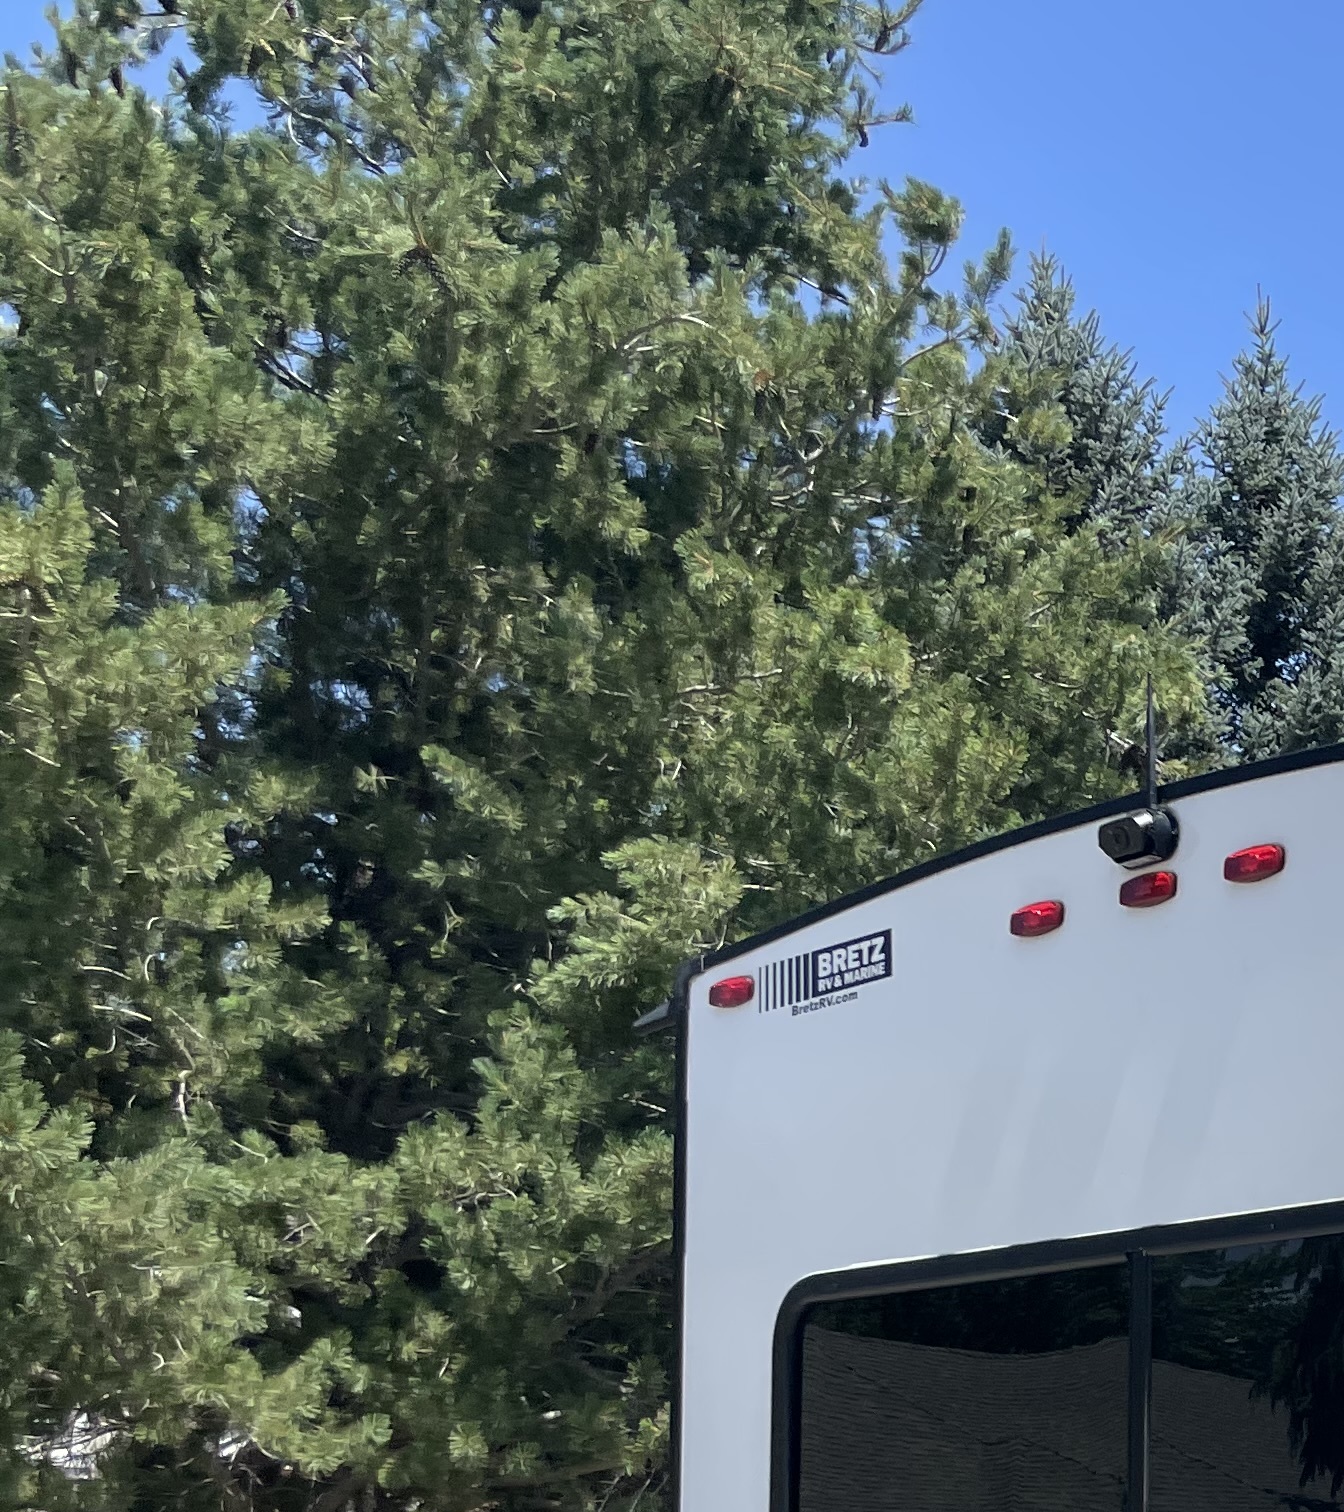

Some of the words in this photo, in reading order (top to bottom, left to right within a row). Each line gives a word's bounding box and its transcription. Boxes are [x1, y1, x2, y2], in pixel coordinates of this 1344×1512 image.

[818, 936, 886, 978] BRETZ
[844, 962, 886, 985] MARINE
[791, 991, 859, 1017] BretzRV.com
